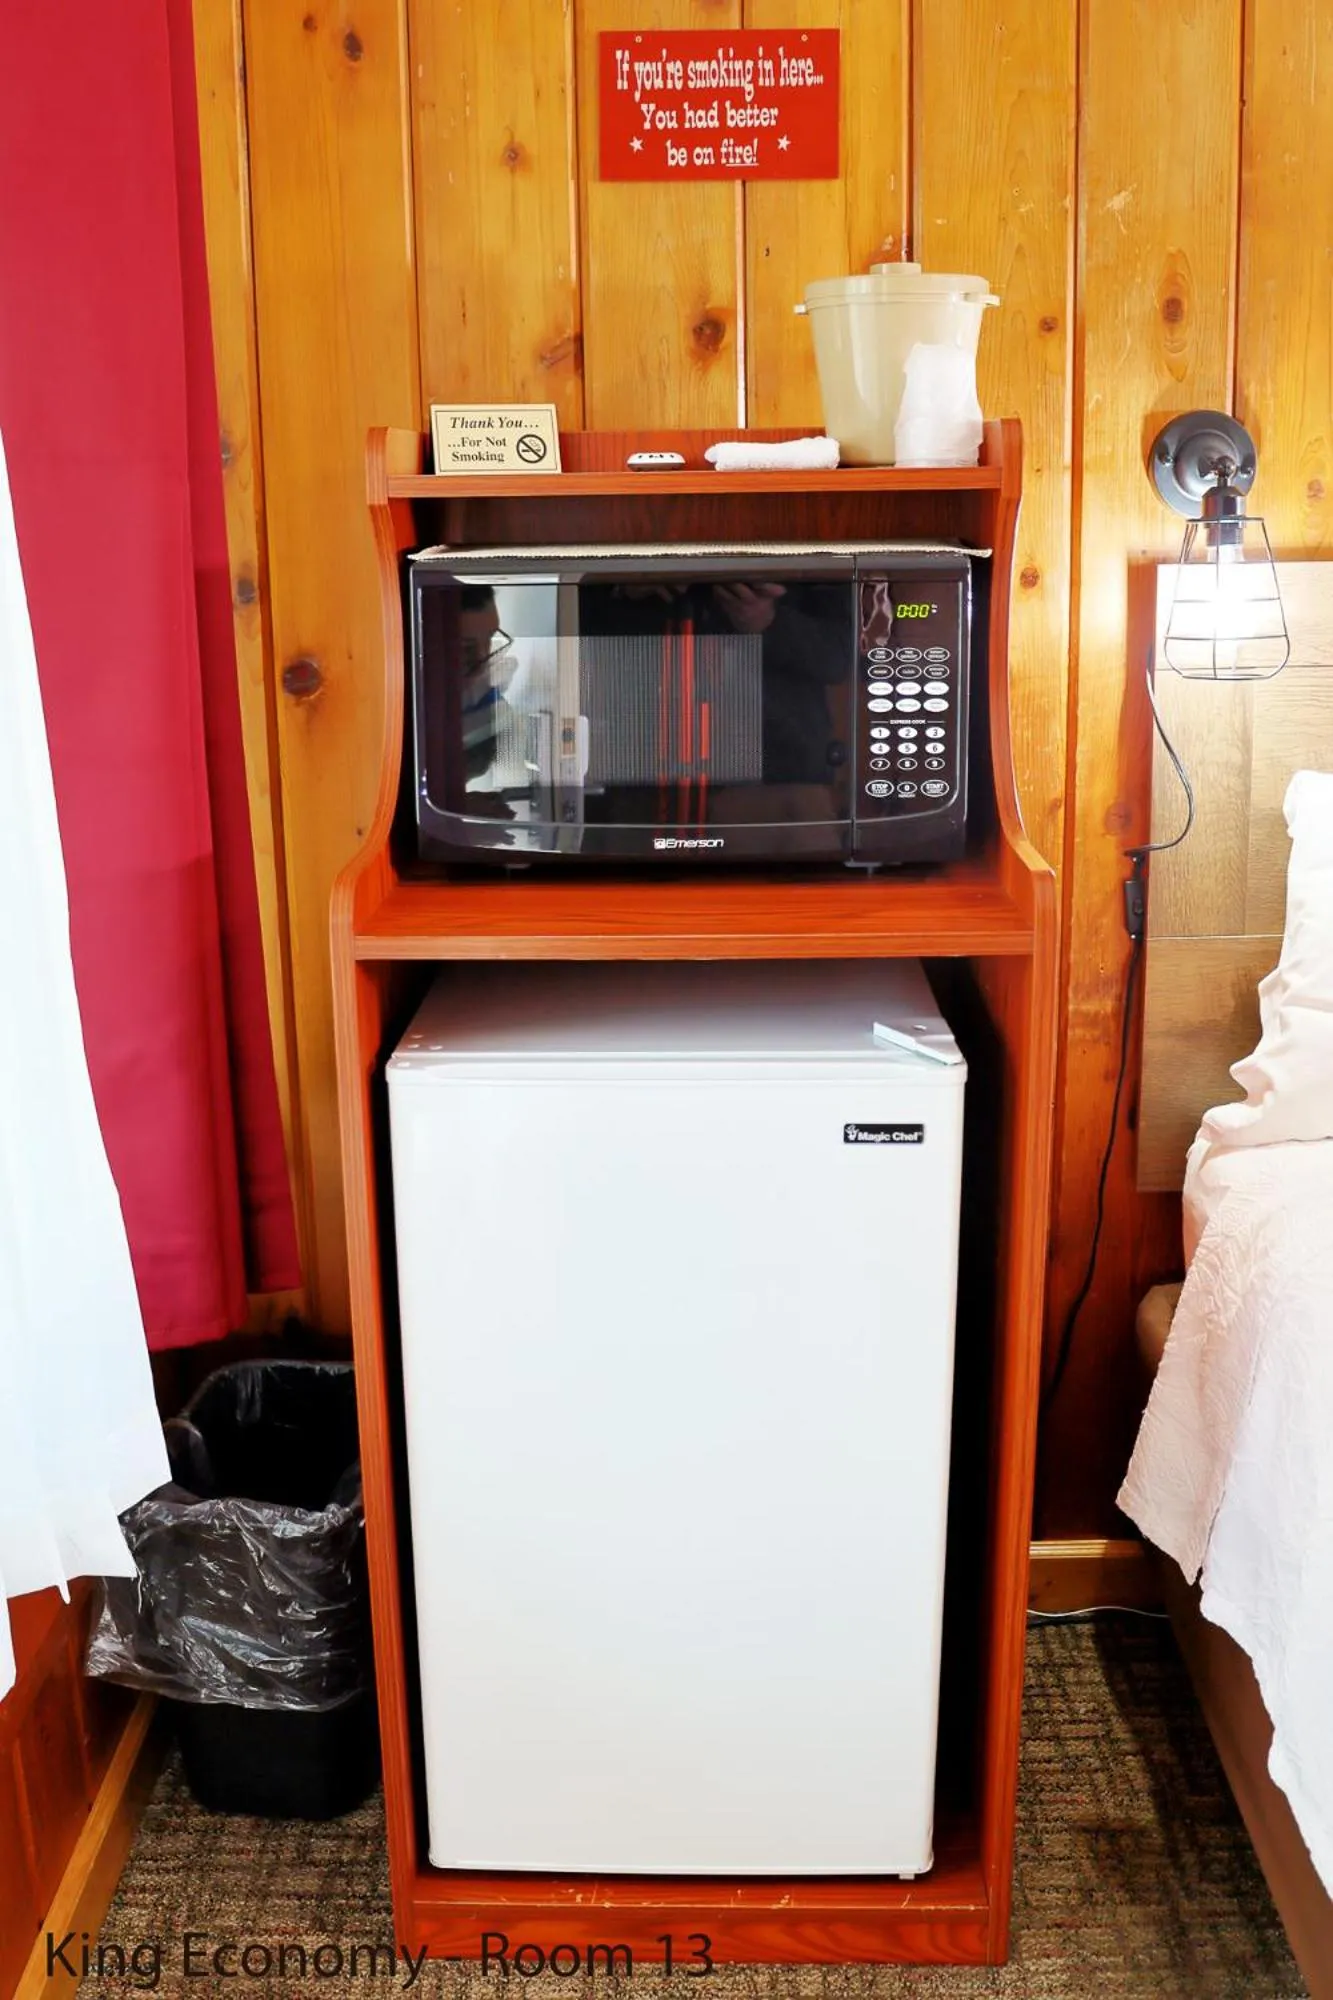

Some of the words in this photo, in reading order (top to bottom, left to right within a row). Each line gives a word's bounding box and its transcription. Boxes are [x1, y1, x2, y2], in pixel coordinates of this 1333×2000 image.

[616, 49, 630, 90] If
[634, 48, 683, 102] you're
[687, 47, 754, 101] smoking
[758, 46, 775, 87] in
[779, 46, 824, 87] here...
[641, 103, 679, 130] You
[684, 100, 719, 128] had
[725, 100, 779, 128] better
[666, 139, 688, 166] be
[693, 146, 715, 165] on
[720, 138, 759, 166] fire!
[450, 417, 495, 429] Thank
[486, 436, 507, 447] Not
[451, 451, 505, 463] Smoking
[896, 604, 929, 618] 0:00
[666, 838, 724, 849] Emerson
[857, 1131, 890, 1142] Magic
[892, 1131, 918, 1141] Chef
